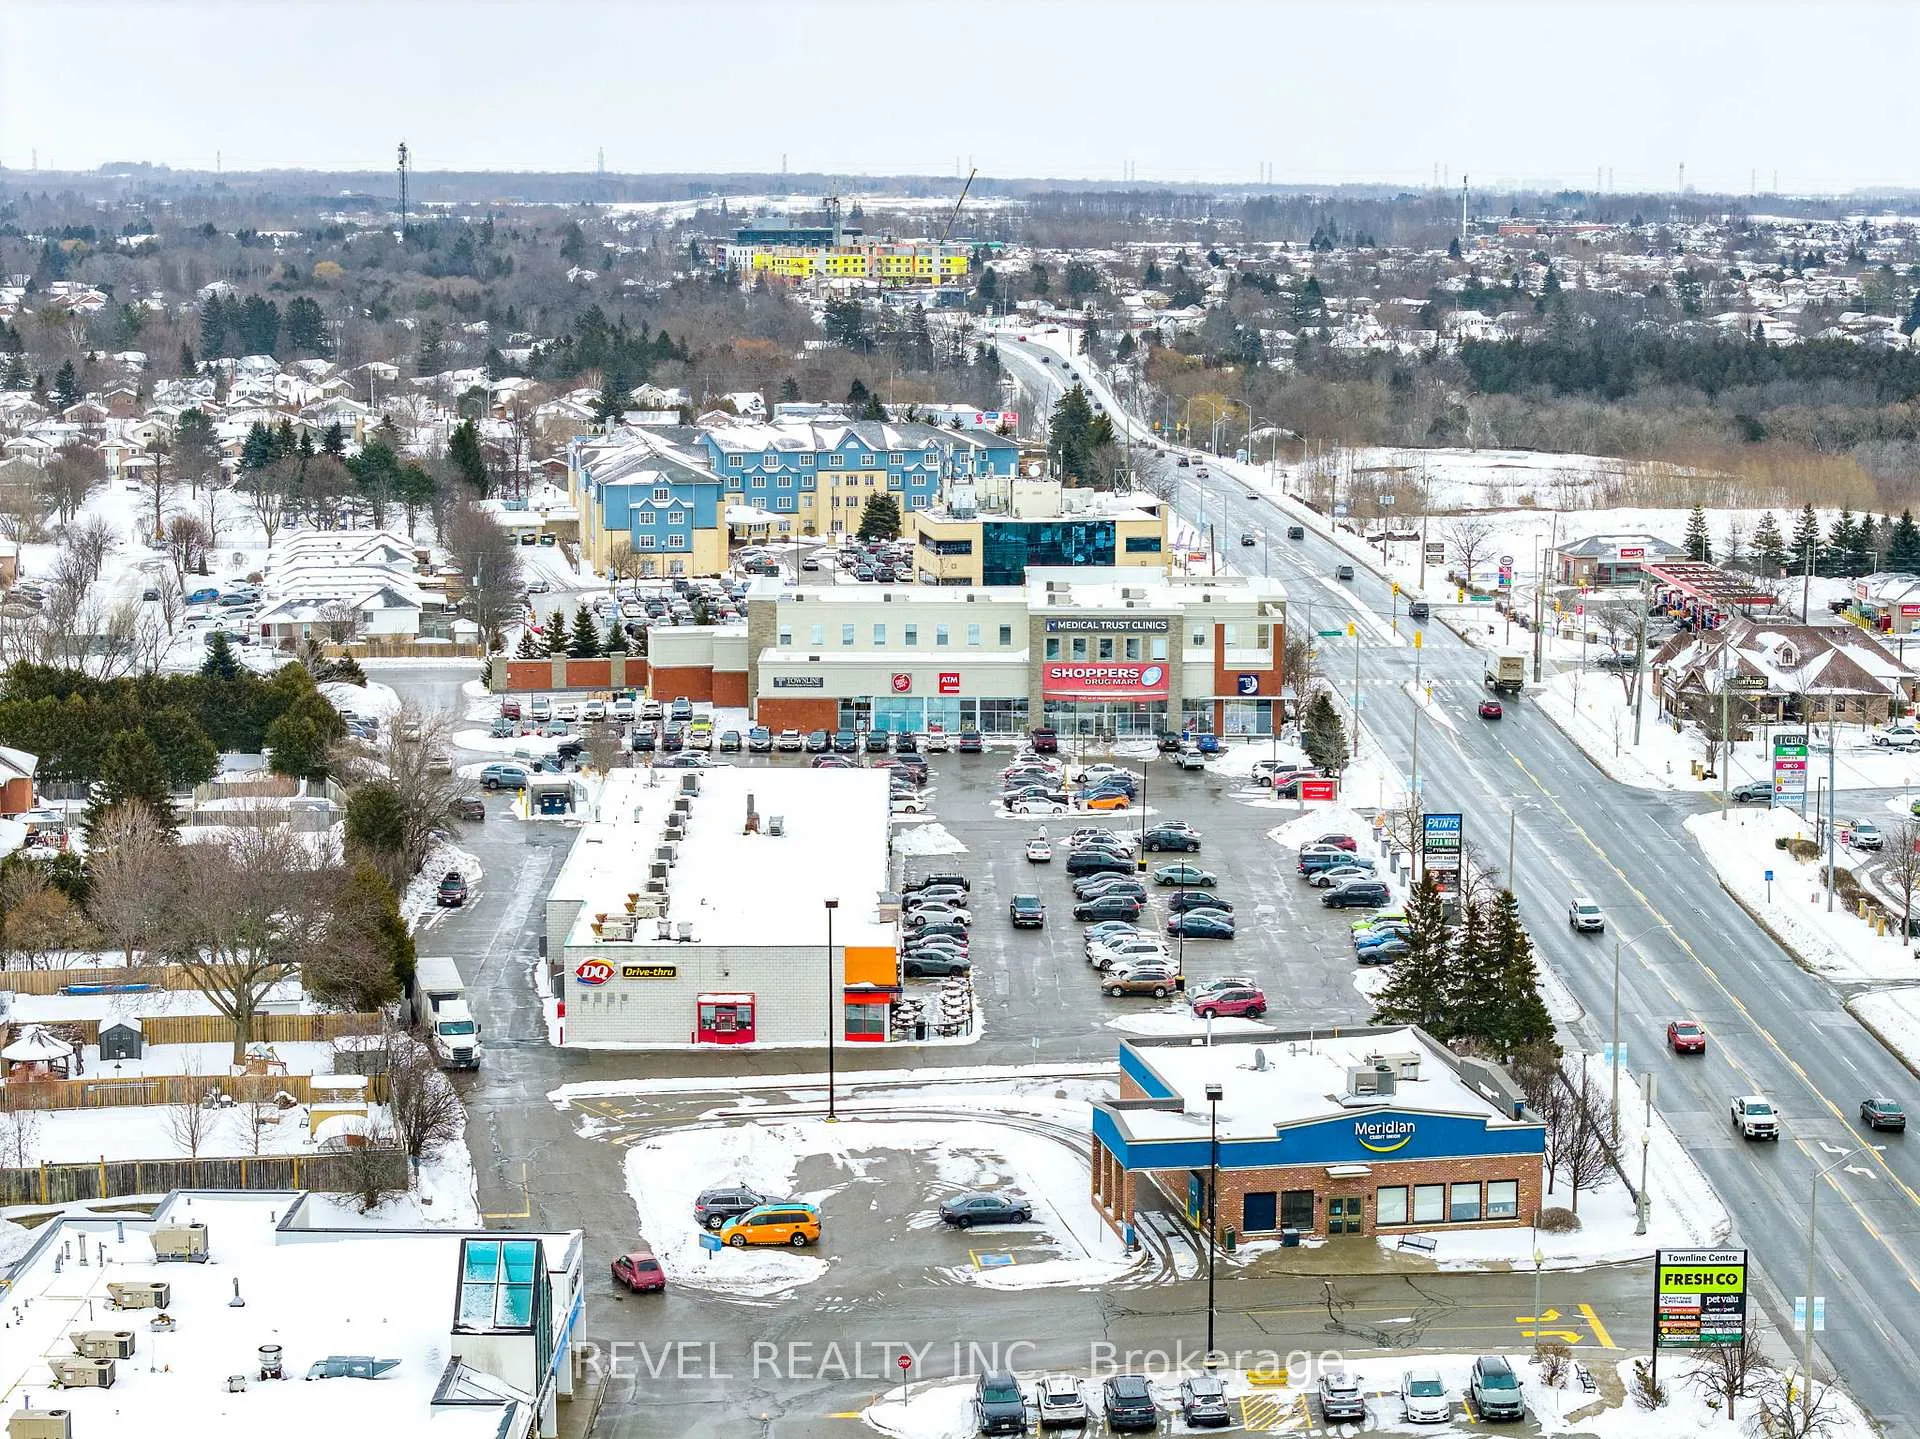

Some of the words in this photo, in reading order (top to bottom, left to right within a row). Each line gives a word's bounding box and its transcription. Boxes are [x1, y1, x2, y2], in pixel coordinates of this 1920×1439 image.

[1057, 620, 1100, 630] MEDICAL
[1101, 620, 1131, 630] TRUST
[1131, 620, 1167, 630] CLINICS
[1050, 668, 1140, 679] SHOPPERS
[941, 676, 958, 684] ATM
[1426, 818, 1459, 829] PAINTS
[1426, 839, 1443, 847] PIZZA
[582, 965, 609, 979] DQ
[625, 968, 674, 976] Drive-thru
[1355, 1121, 1416, 1135] Meridian
[1668, 1253, 1707, 1262] Townline
[1708, 1253, 1738, 1262] Centre
